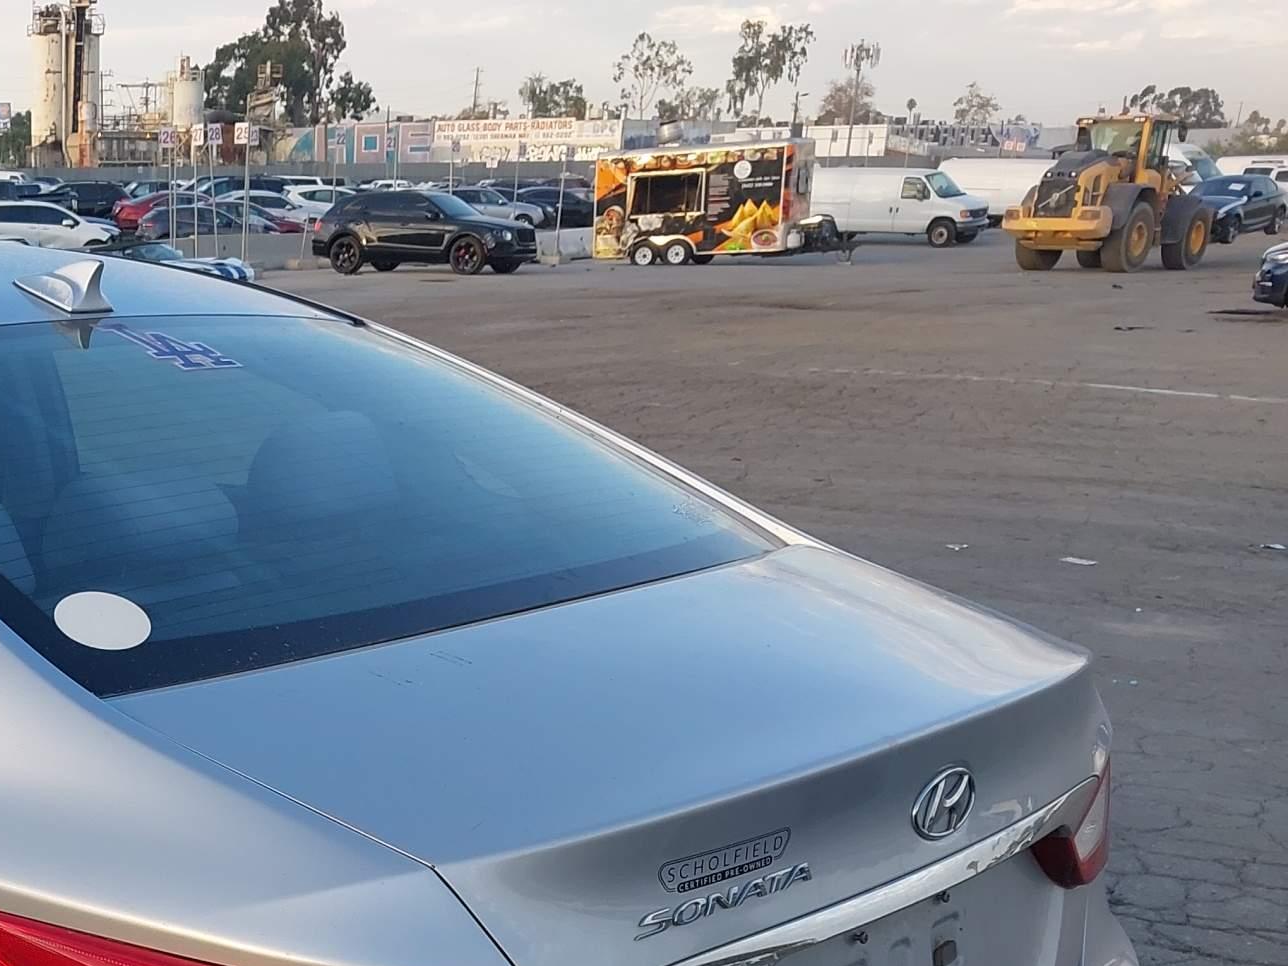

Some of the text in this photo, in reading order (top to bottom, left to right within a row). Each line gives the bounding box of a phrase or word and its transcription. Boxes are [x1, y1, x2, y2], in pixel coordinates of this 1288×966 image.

[208, 127, 220, 141] 28
[336, 132, 346, 145] 22
[437, 122, 455, 132] AUTO
[457, 122, 480, 132] GLASS
[482, 122, 502, 131] BODY
[667, 835, 783, 883] SCHOLFIELD
[678, 857, 772, 893] CERTIFIED PRE-OWNED
[634, 862, 812, 941] SONATA
